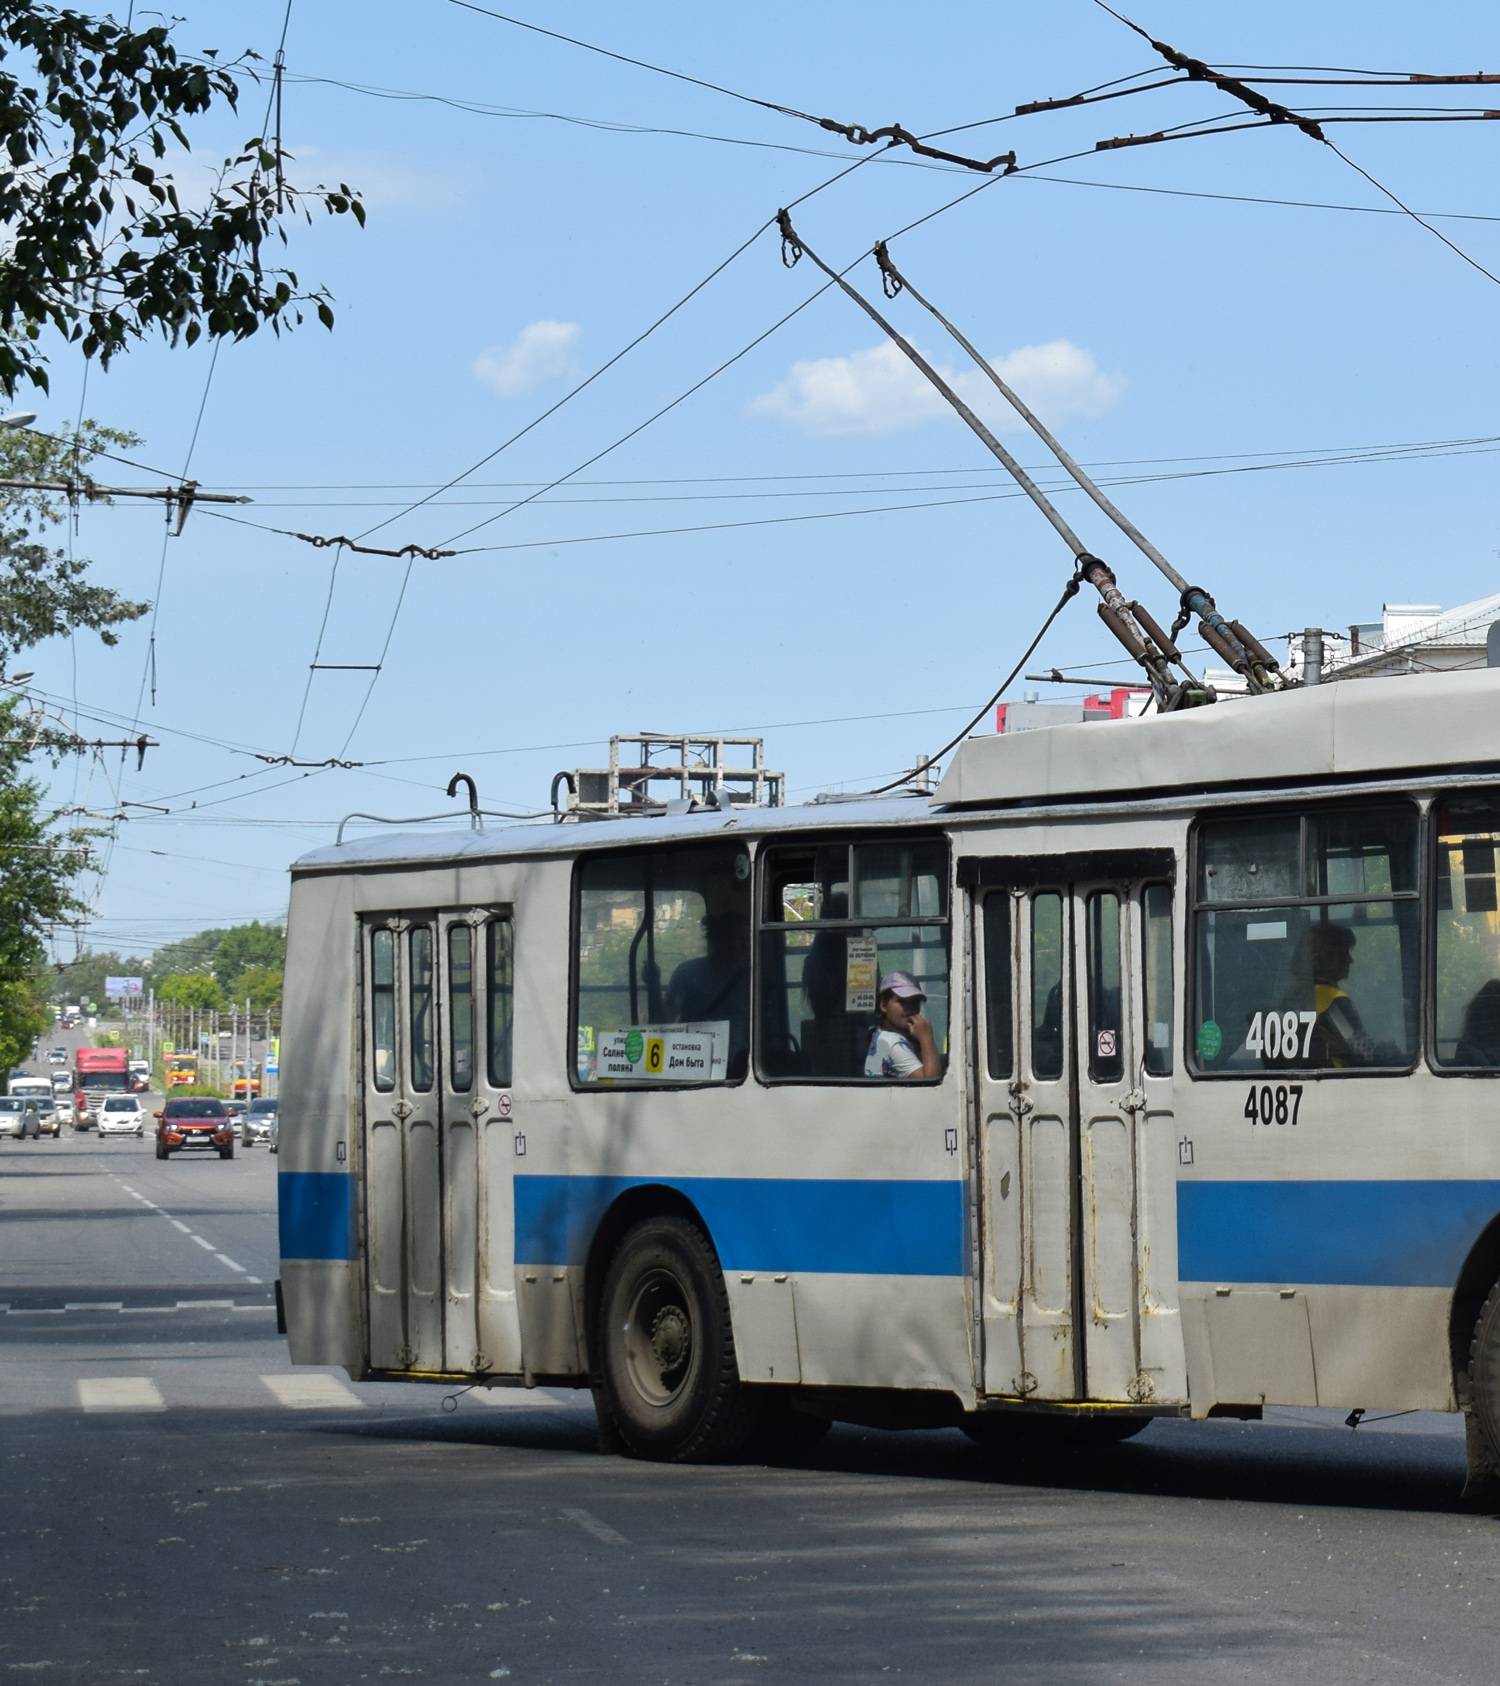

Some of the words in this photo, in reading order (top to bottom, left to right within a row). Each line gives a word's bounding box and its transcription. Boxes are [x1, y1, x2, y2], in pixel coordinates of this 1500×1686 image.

[1245, 1011, 1317, 1059] 4087
[650, 1043, 660, 1068] 6
[672, 1043, 701, 1052] остановка
[608, 1063, 633, 1073] поляна
[669, 1056, 685, 1069] Дом
[686, 1056, 704, 1069] быта
[1244, 1085, 1303, 1125] 4087
